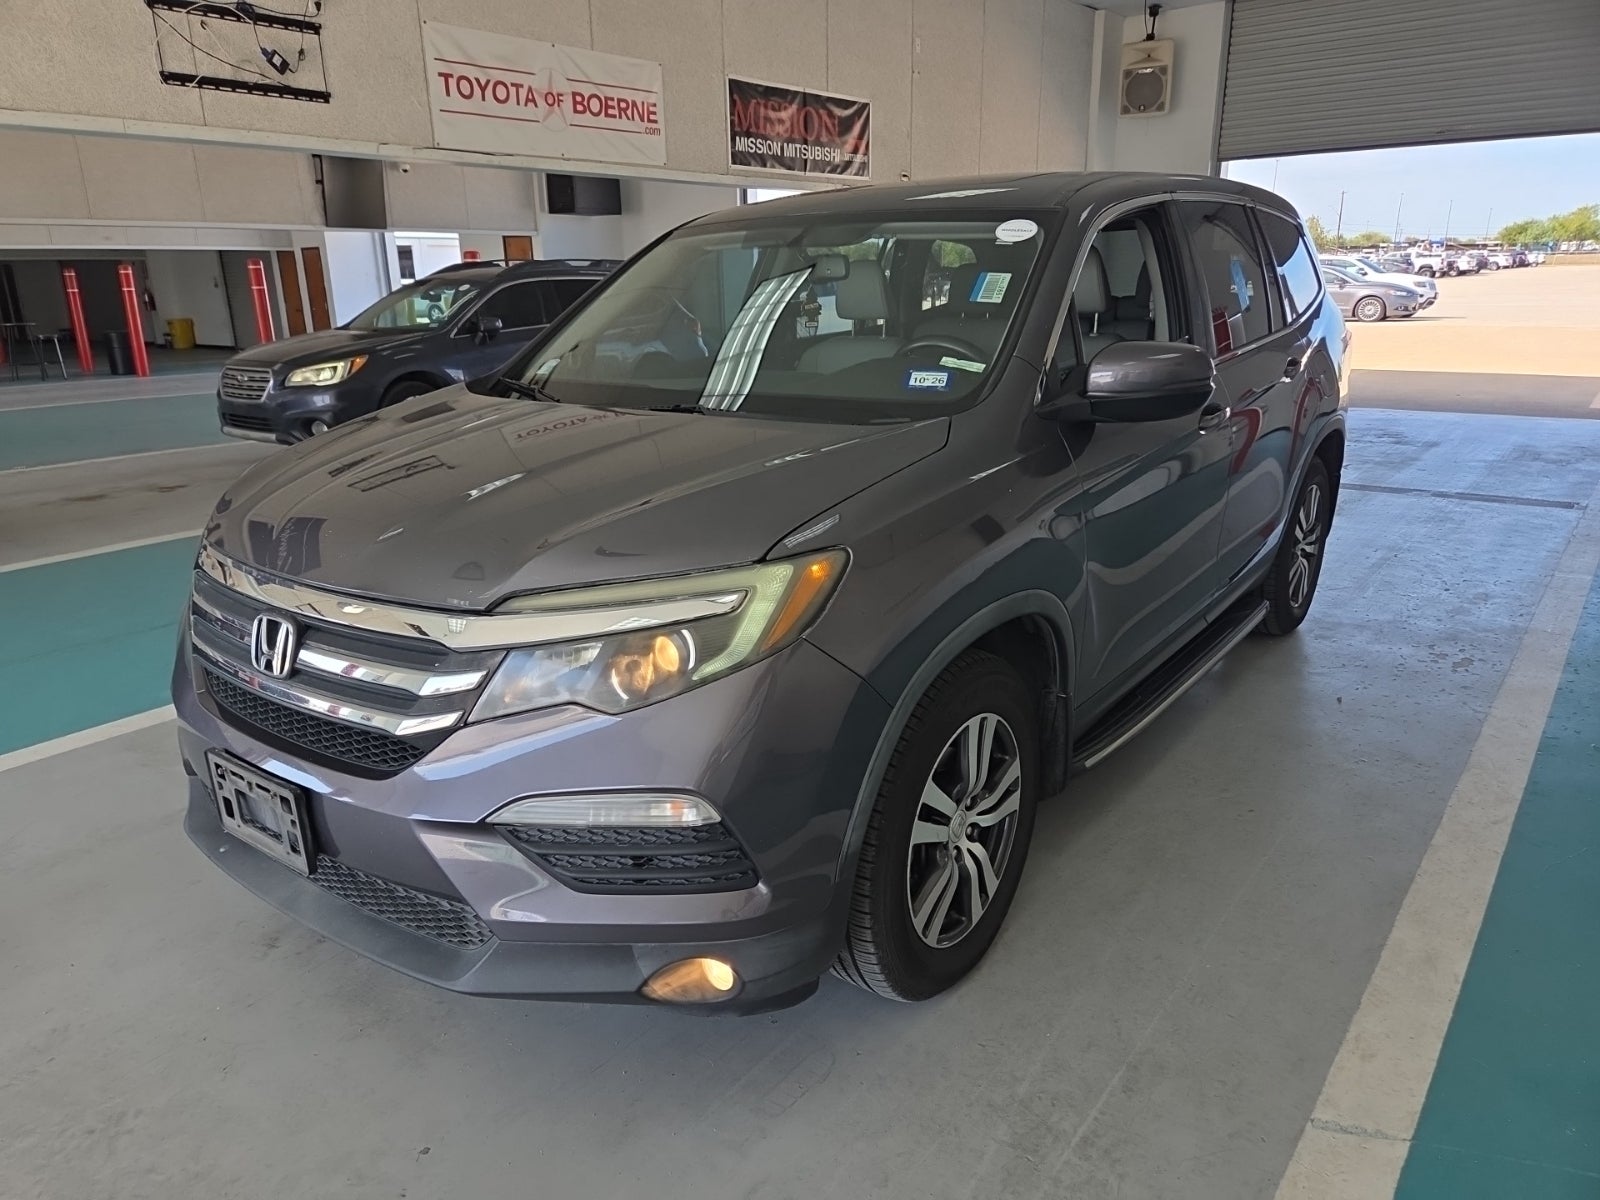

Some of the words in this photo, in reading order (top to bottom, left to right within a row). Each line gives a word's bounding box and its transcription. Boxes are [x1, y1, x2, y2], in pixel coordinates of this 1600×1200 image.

[437, 71, 539, 108] TOYOTA
[544, 91, 564, 107] OF
[571, 91, 658, 124] BOERNE
[732, 94, 841, 143] MISSION
[735, 136, 781, 156] MISSION
[783, 142, 841, 163] MITSUBISHI
